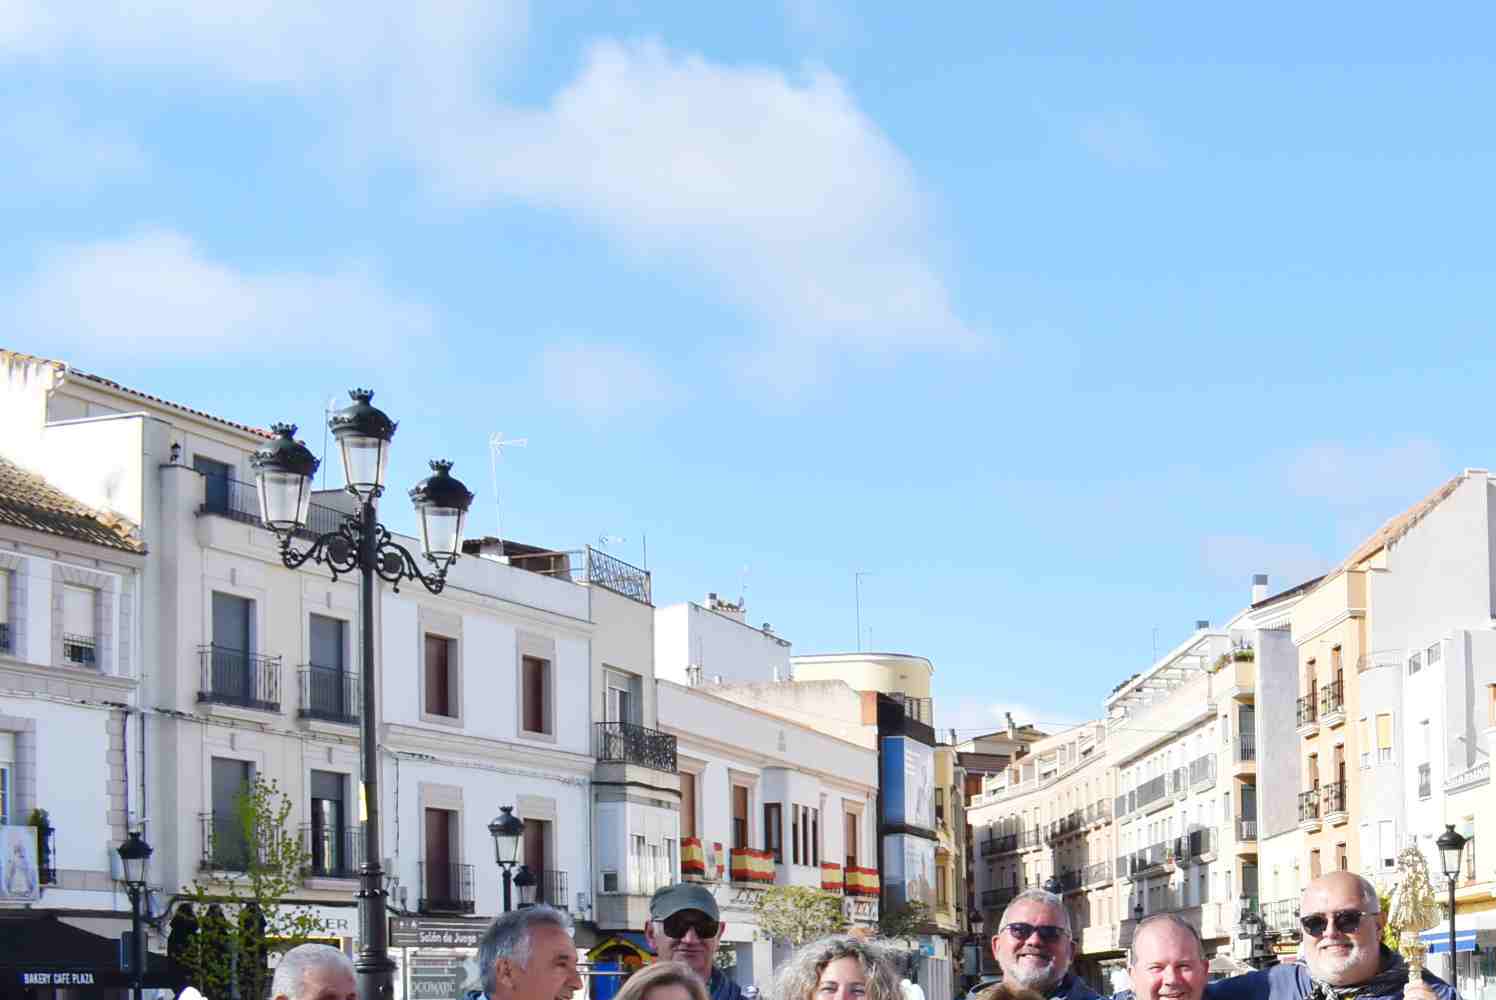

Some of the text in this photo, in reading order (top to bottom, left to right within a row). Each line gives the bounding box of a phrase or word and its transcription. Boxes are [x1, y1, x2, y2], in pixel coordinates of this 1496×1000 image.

[419, 931, 441, 943] Salón
[443, 931, 453, 943] de
[24, 972, 95, 985] BAKERY CAFE PLAZA
